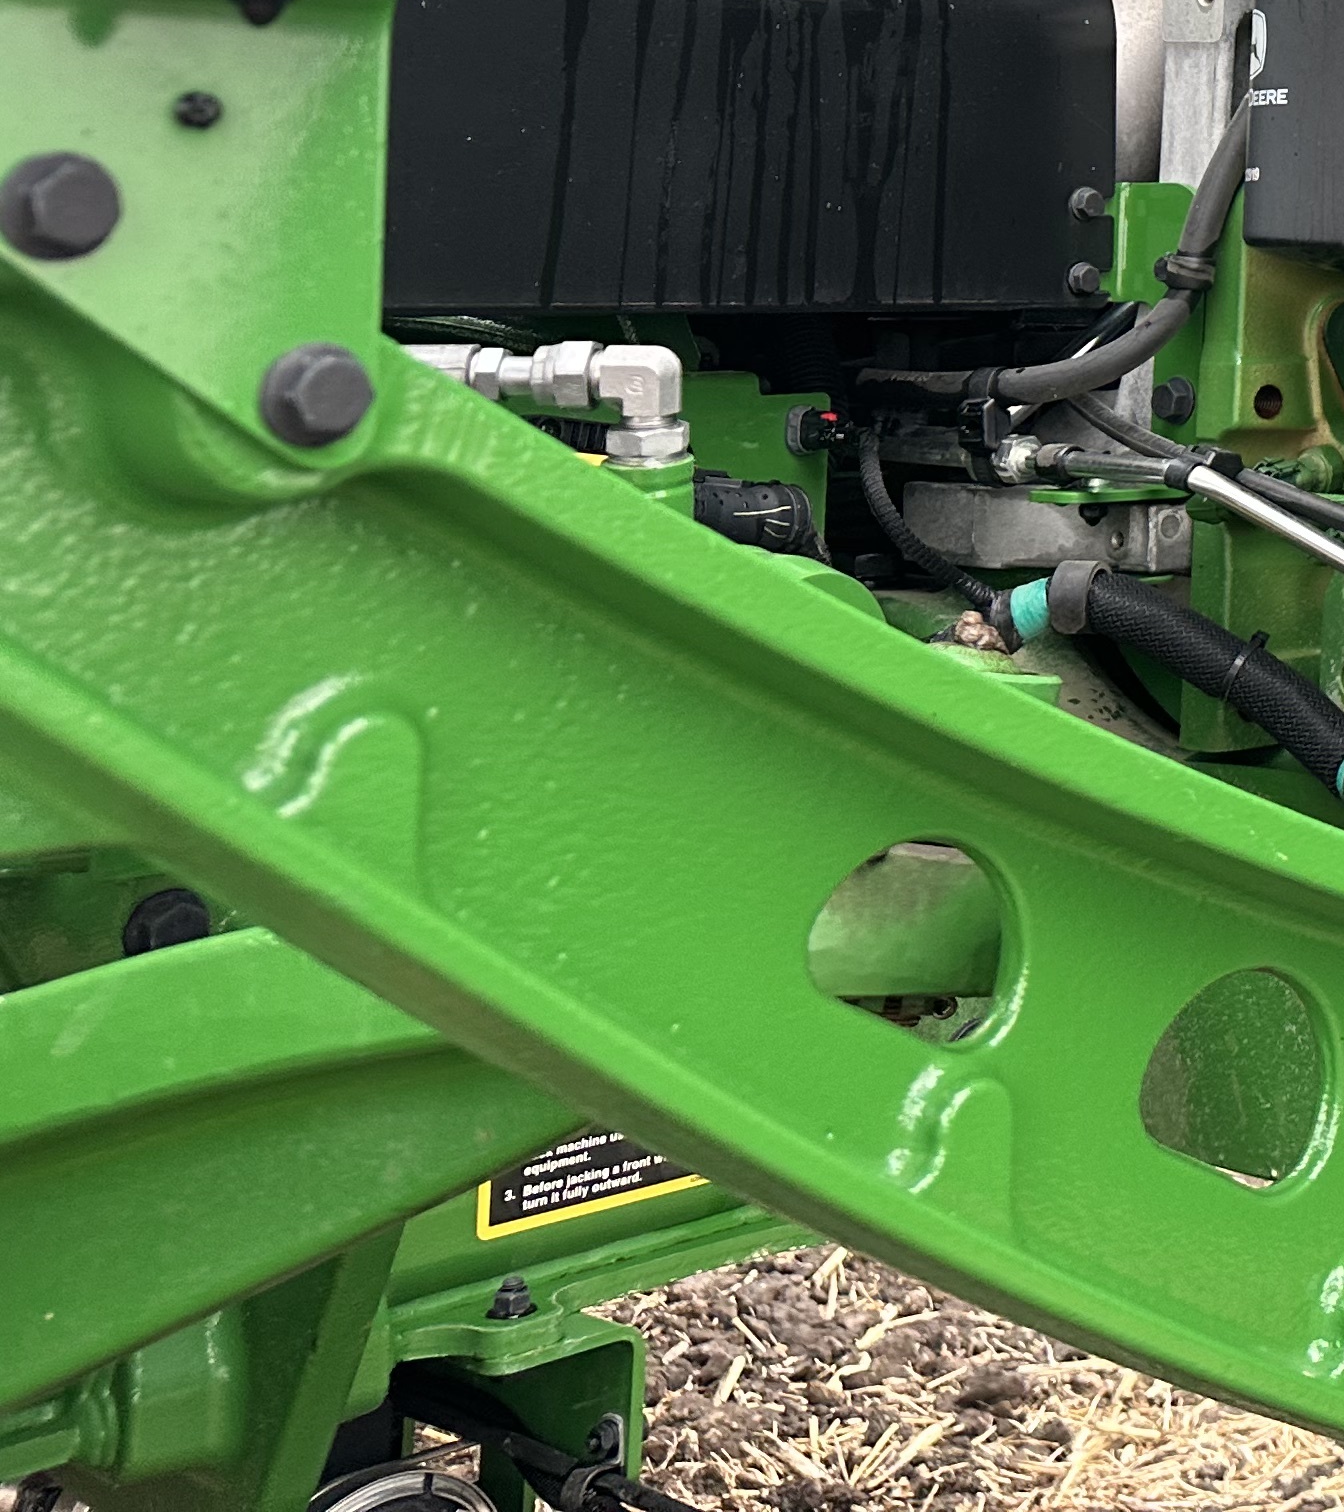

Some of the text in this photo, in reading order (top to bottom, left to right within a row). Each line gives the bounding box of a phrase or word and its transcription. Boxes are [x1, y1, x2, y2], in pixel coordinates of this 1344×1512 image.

[556, 1133, 607, 1155] machine
[504, 1190, 516, 1202] 3.
[522, 1180, 563, 1198] Before
[565, 1165, 610, 1189] jacking
[612, 1165, 620, 1175] a
[622, 1154, 651, 1173] front
[523, 1151, 592, 1177] equipment.
[522, 1171, 643, 1211] turn it fully outward.
